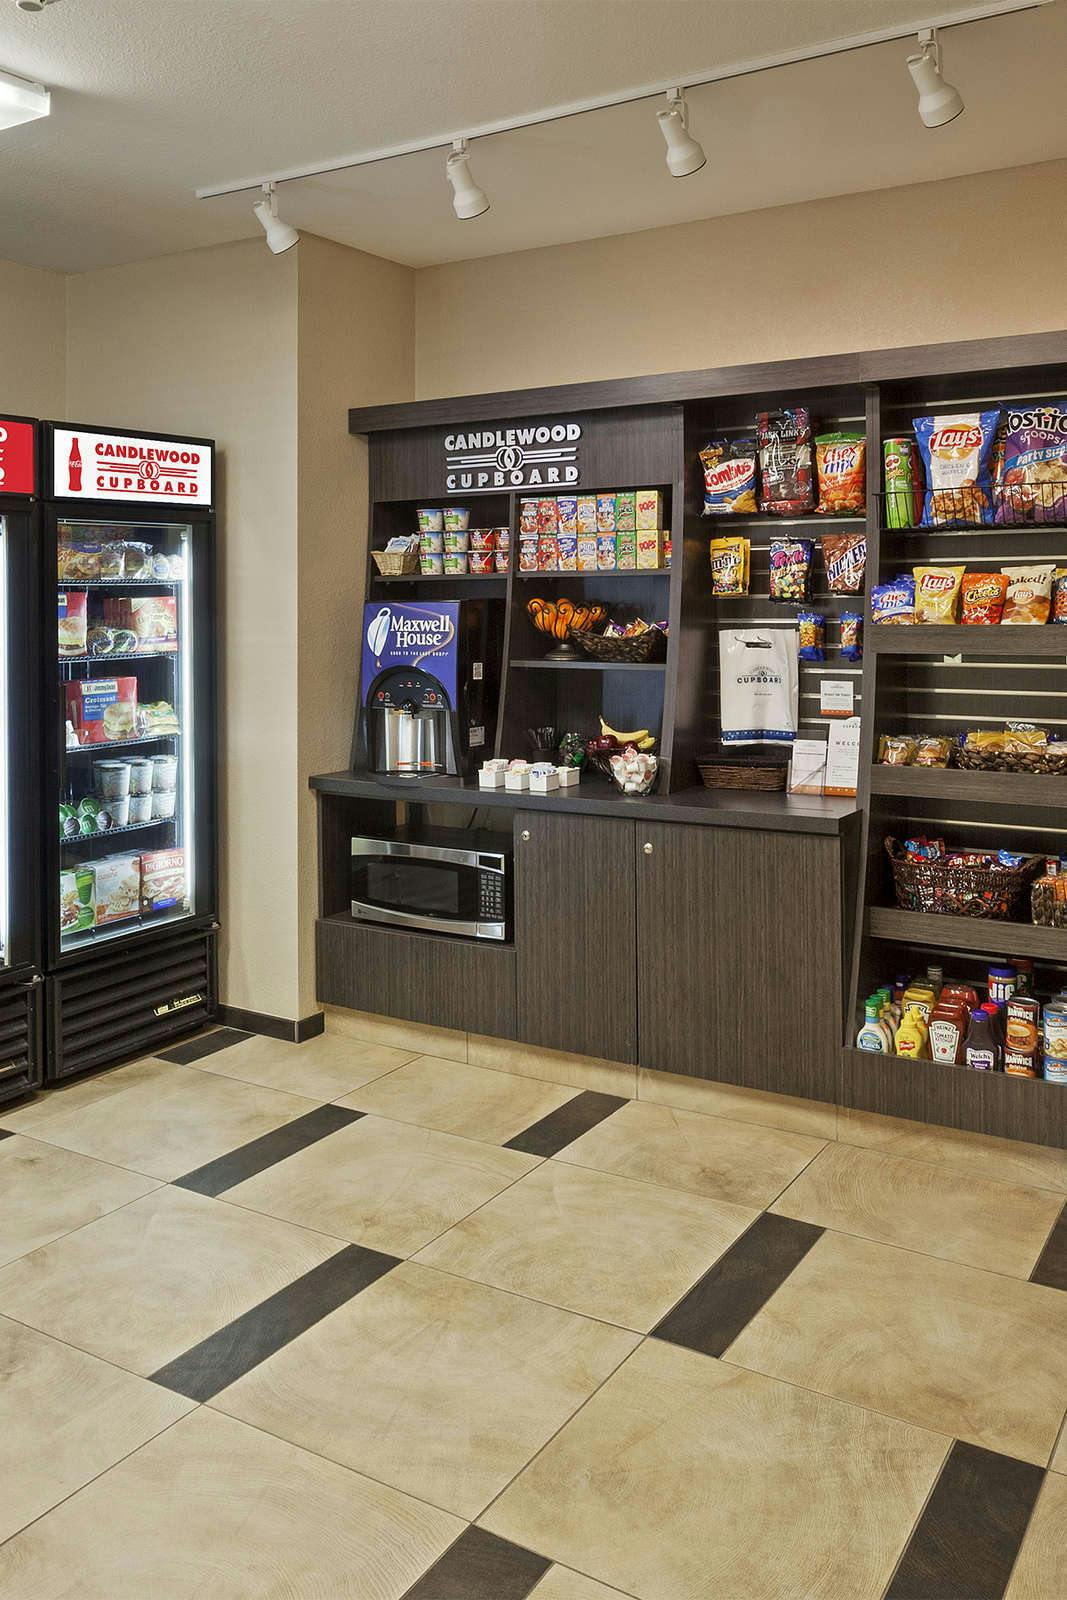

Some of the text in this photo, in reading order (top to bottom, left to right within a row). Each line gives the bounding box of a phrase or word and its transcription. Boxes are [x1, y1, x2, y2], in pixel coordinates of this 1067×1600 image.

[444, 423, 581, 451] CANDLEWOOD
[94, 442, 201, 465] CANDLEWOOD
[96, 475, 199, 494] CUPBOARD
[446, 466, 579, 489] CUPBOARD
[638, 500, 657, 512] POPS
[638, 540, 657, 552] POPS
[390, 614, 450, 632] Maxwell
[396, 631, 442, 648] House
